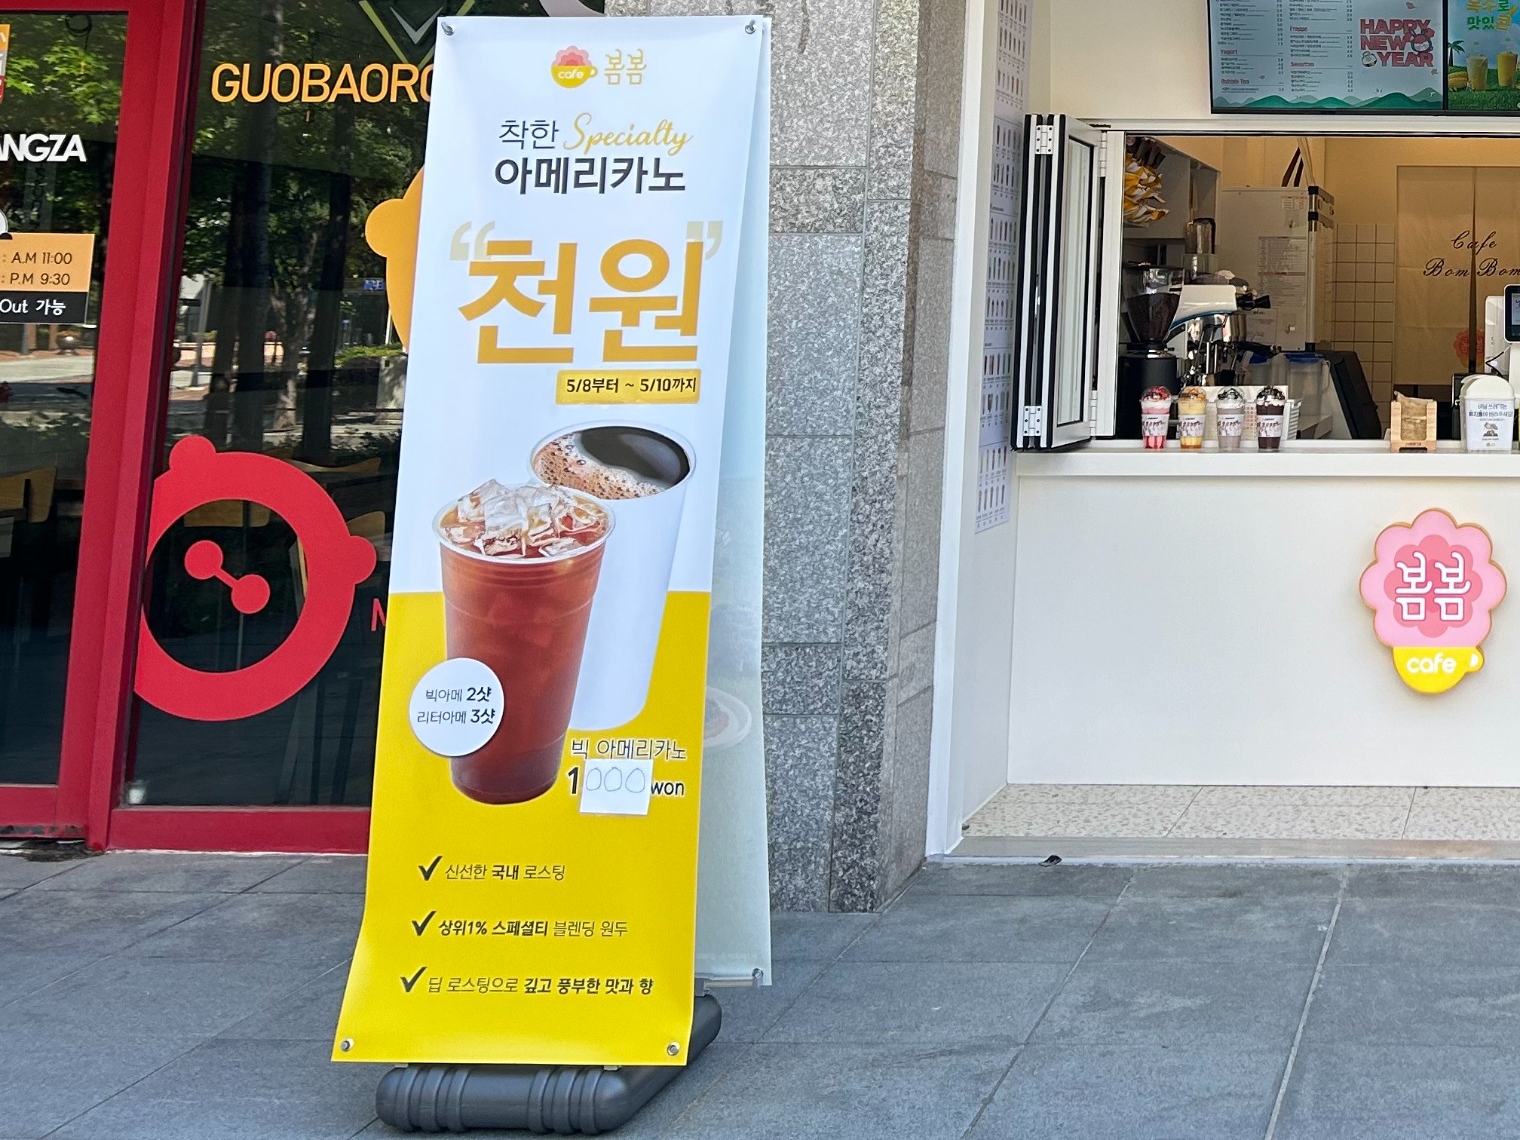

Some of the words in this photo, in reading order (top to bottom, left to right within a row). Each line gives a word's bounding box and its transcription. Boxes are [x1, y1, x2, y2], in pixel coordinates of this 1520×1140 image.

[1360, 18, 1432, 35] HAPPY
[1360, 35, 1406, 51] NEW
[604, 48, 647, 85] 봄봄
[1377, 51, 1434, 68] YEAR
[557, 69, 584, 80] cafe
[499, 119, 559, 150] 착한
[563, 112, 693, 156] Specialty
[494, 156, 686, 195] 아메리카노
[1451, 230, 1500, 255] Cafe
[11, 252, 37, 264] A.M
[42, 252, 73, 265] 11:00
[1422, 257, 1470, 278] Bom
[10, 272, 34, 285] P.M
[40, 272, 70, 286] 9:30
[0, 298, 28, 313] Out
[35, 299, 66, 316] 가능
[566, 377, 619, 394] 5/8부터
[639, 377, 697, 394] 5/10까지
[1395, 551, 1471, 621] 봄봄
[1406, 652, 1457, 674] cafe
[425, 688, 462, 702] 빅아메
[466, 686, 492, 702] 2샷
[417, 710, 466, 725] 리터아메
[470, 708, 496, 725] 3샷
[572, 739, 589, 759] 빅
[597, 739, 687, 760] 아메리카노
[445, 864, 487, 880] 신선한
[491, 864, 519, 880] 국내
[524, 864, 566, 880] 로스팅
[438, 920, 488, 936] 상위1%
[491, 920, 548, 936] 스페셜티
[553, 920, 595, 937] 블렌딩
[600, 920, 628, 937] 원두
[428, 977, 442, 993] 딥
[447, 977, 519, 993] 로스팅으로
[524, 978, 551, 994] 깊고
[557, 978, 600, 994] 풍부한
[605, 978, 634, 994] 맛과
[639, 978, 654, 995] 향
